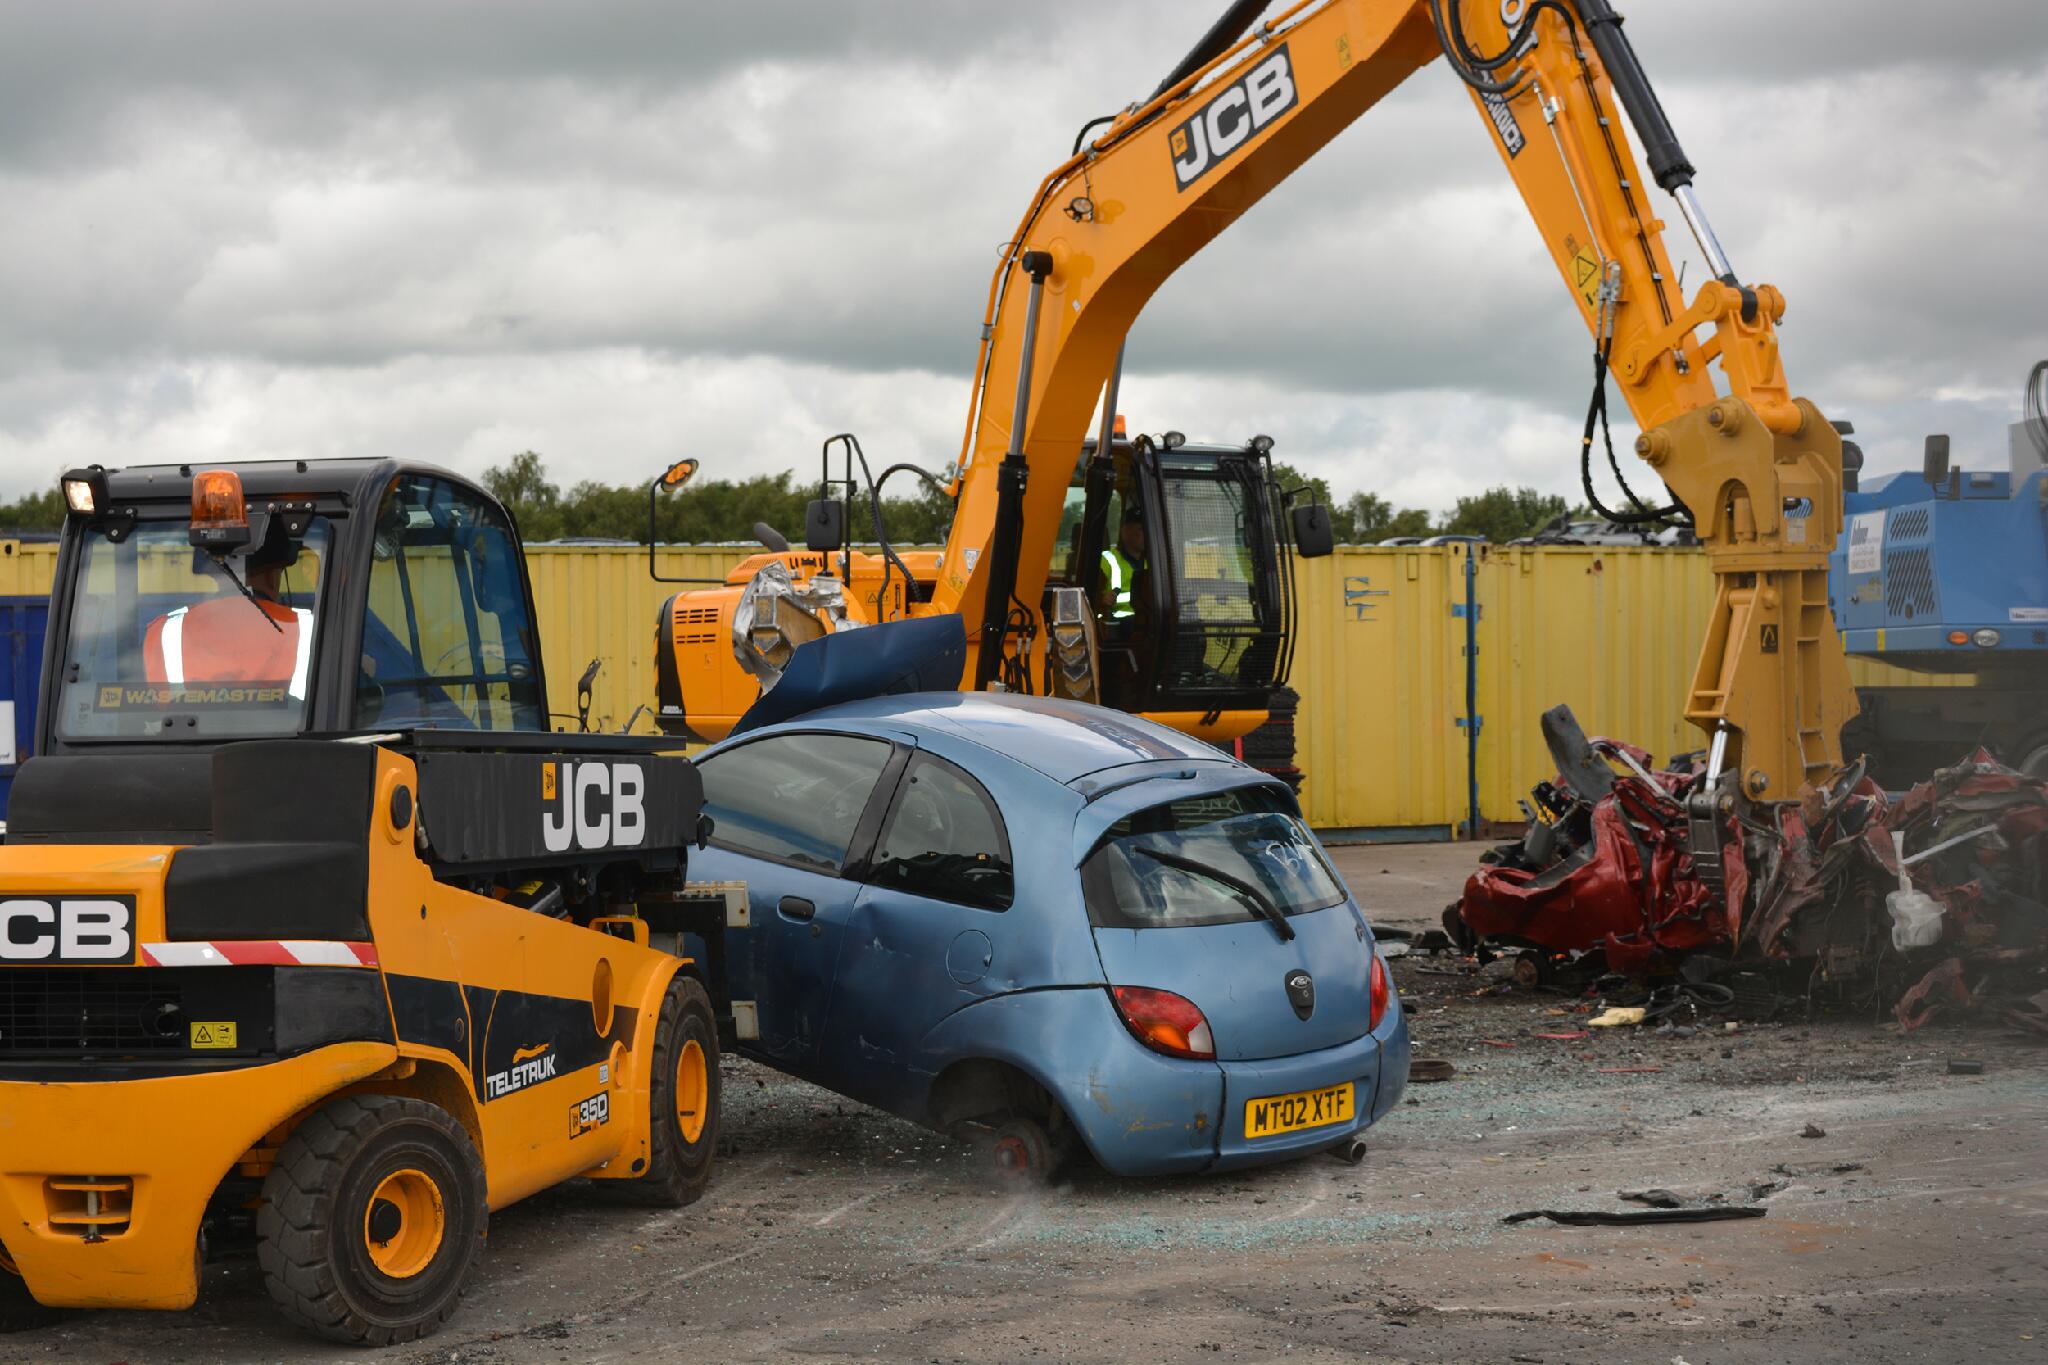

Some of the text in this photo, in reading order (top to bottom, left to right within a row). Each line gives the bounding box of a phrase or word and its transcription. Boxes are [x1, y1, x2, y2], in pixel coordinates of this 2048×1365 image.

[1176, 54, 1294, 183] JCB
[127, 687, 285, 704] WASTEMASTER
[543, 762, 646, 852] JCB
[487, 1054, 556, 1098] TELETRUK
[1255, 1089, 1346, 1132] MT02 XTF
